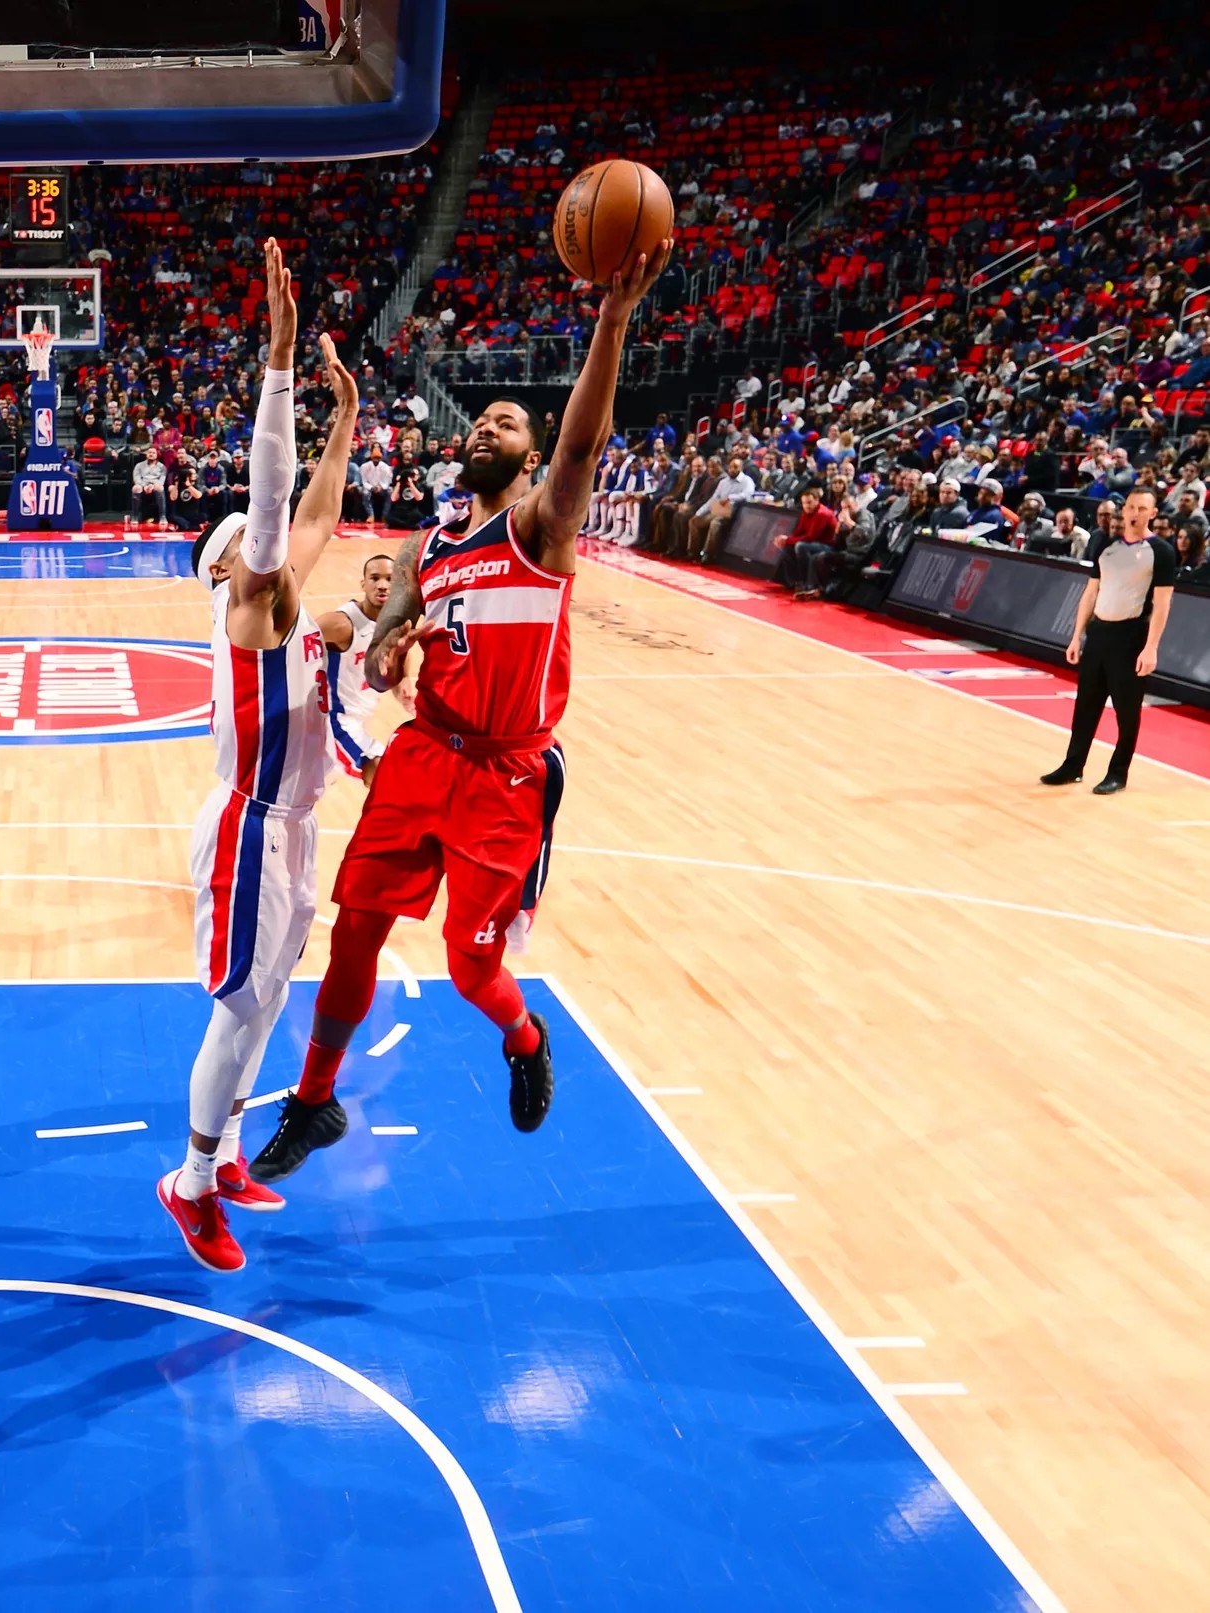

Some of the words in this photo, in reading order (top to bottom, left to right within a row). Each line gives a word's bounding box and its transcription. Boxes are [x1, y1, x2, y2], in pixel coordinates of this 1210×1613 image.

[298, 16, 317, 43] BA
[28, 179, 60, 197] 3:36
[32, 197, 56, 226] 15
[27, 230, 64, 239] TISSOT
[38, 480, 70, 516] FIT
[447, 597, 470, 655] 5
[37, 652, 140, 716] DETROIT
